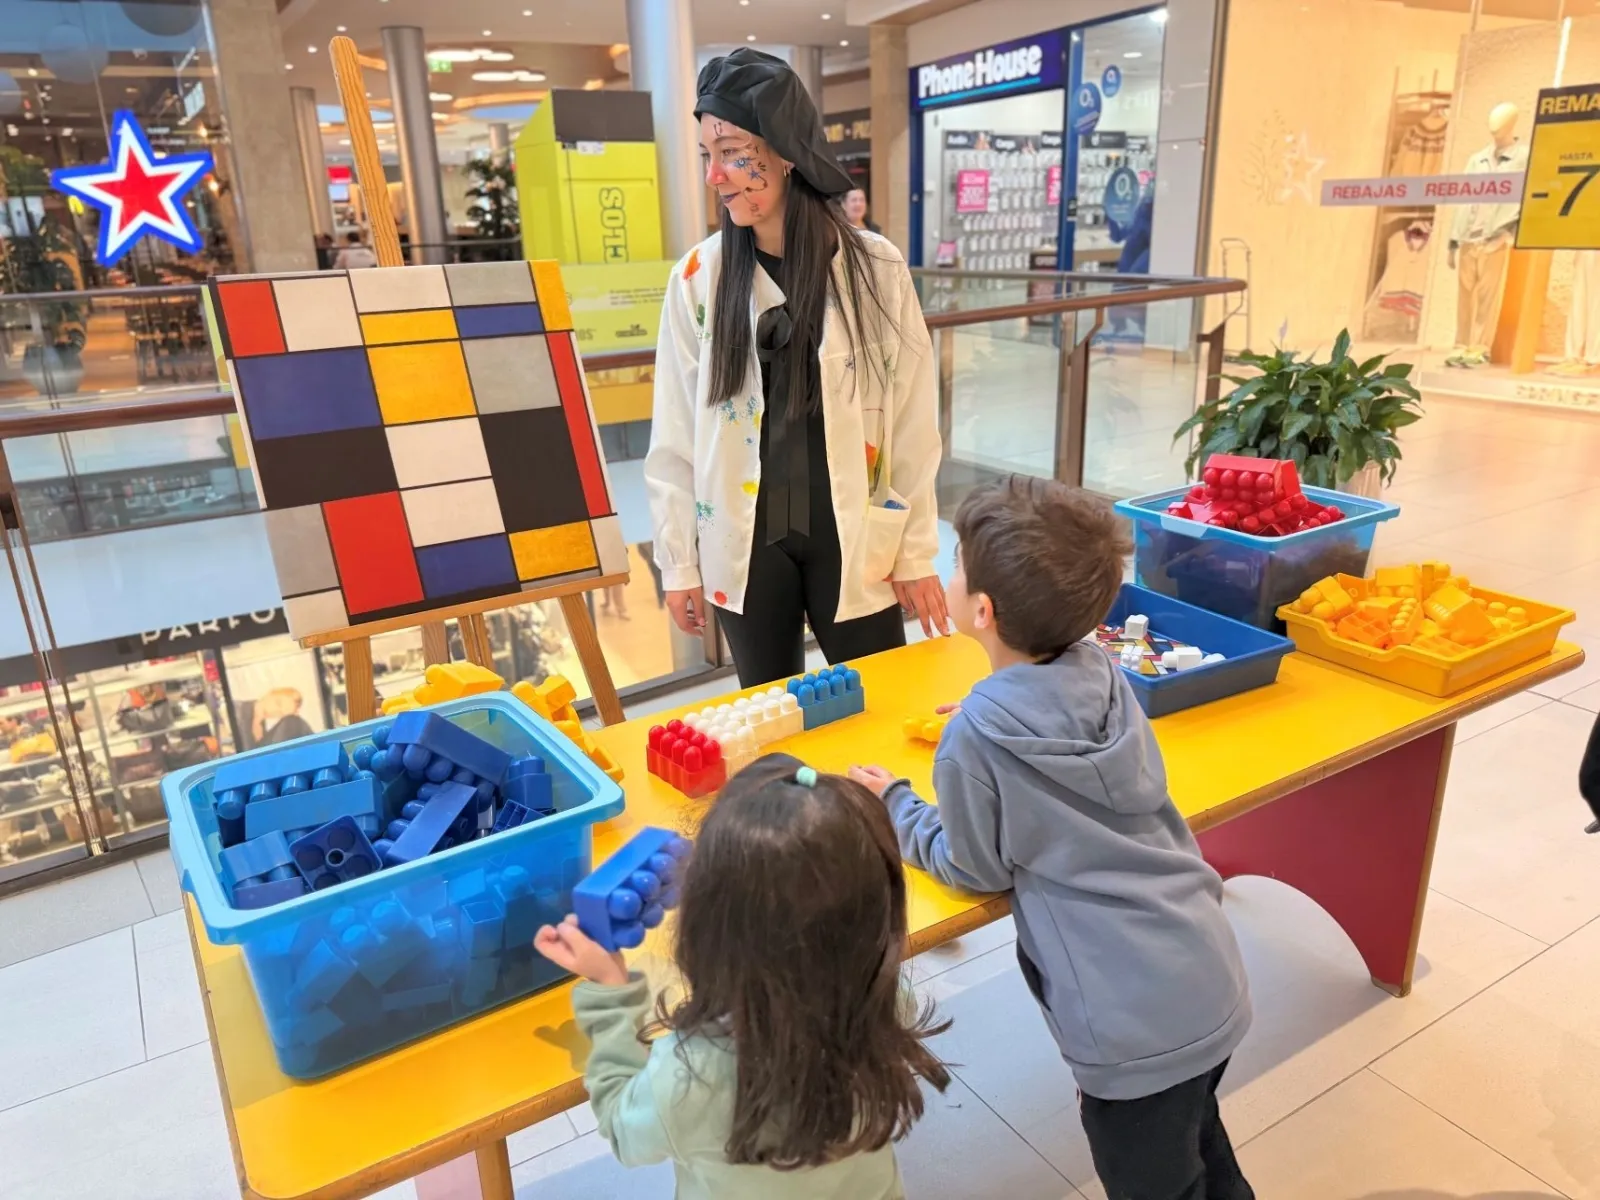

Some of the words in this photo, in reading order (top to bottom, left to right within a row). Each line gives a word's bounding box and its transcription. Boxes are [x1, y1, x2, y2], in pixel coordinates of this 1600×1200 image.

[1559, 151, 1594, 161] HASTA
[1332, 183, 1407, 200] REBAJAS
[1424, 179, 1512, 197] REBAJAS
